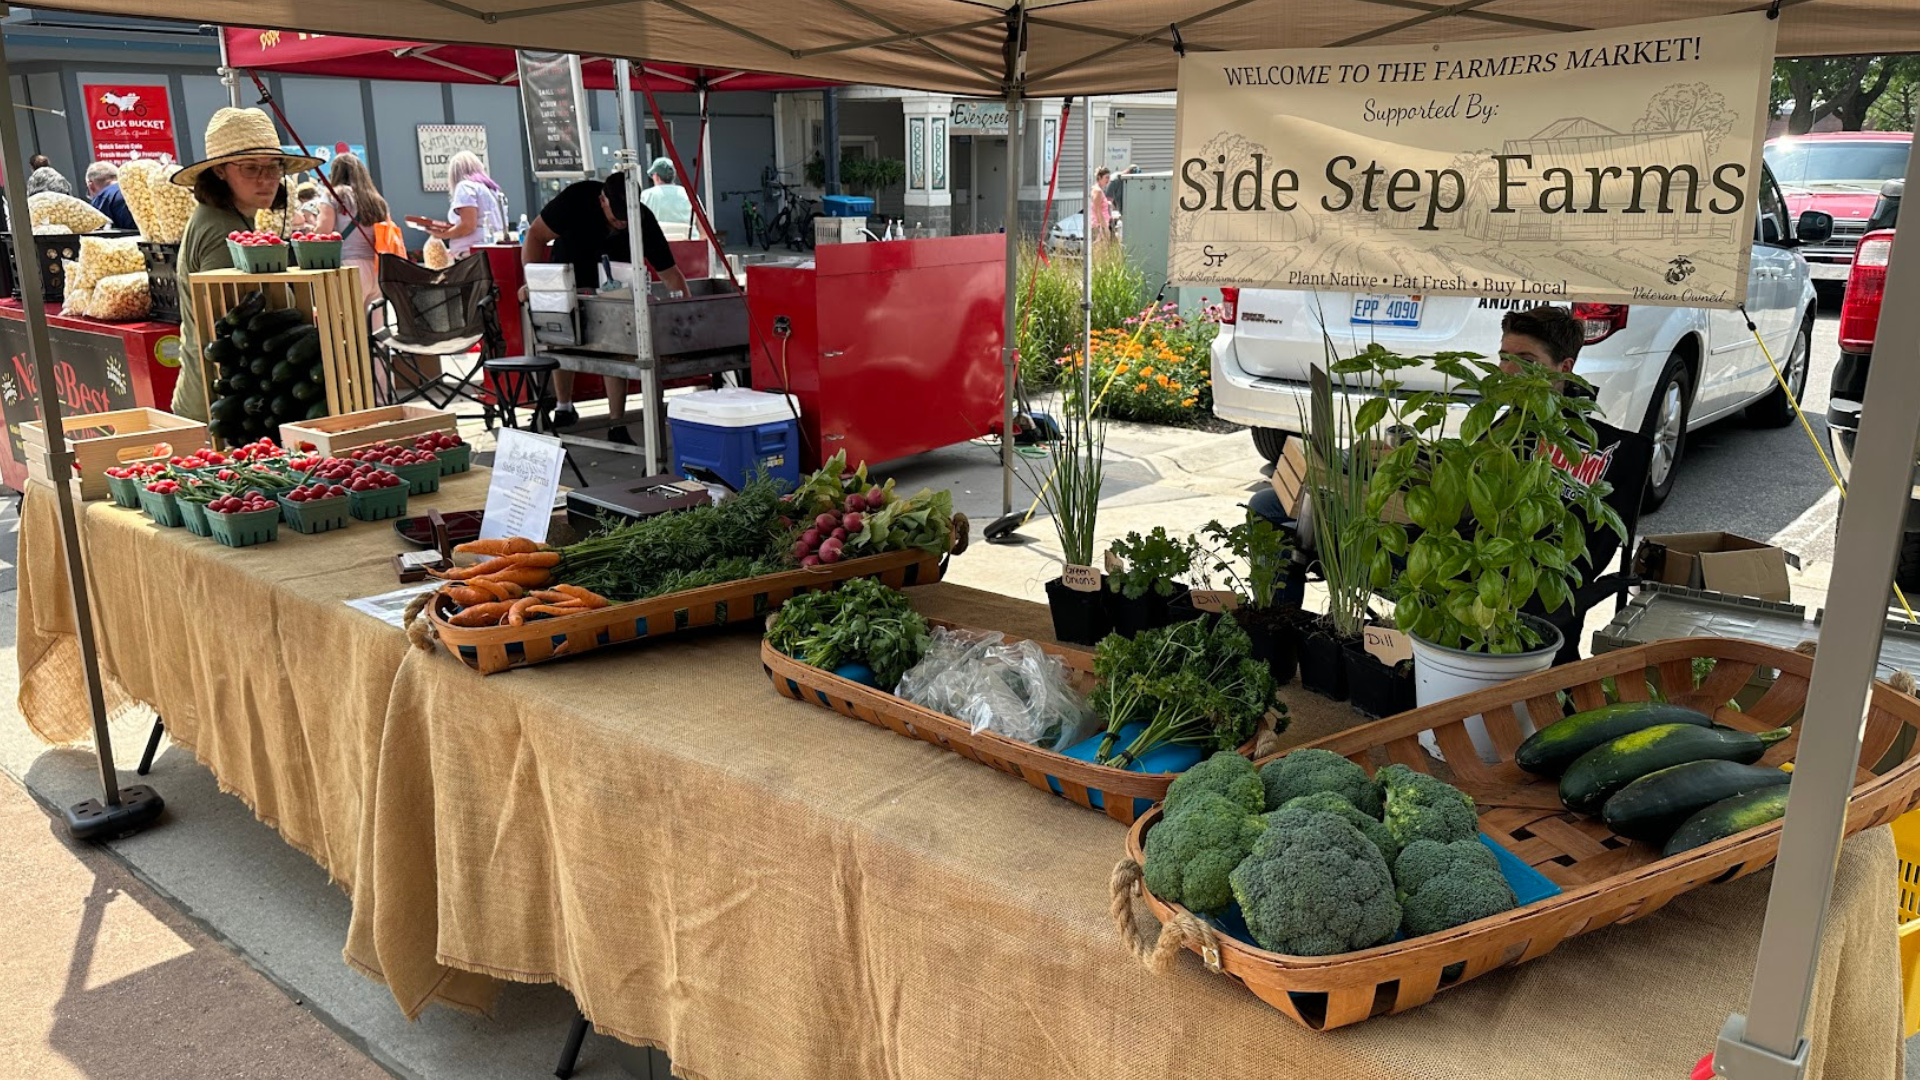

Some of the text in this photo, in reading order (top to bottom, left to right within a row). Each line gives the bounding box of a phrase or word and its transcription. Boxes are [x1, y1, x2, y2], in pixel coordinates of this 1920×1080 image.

[1223, 36, 1702, 86] WELCOME TO THE FARMERS MARKET!
[1363, 93, 1500, 127] Supported By:
[96, 120, 165, 131] CLUCK BUCKET
[913, 126, 922, 179] GROCERY
[934, 127, 943, 181] PRODUCE
[1178, 153, 1747, 231] Side Step Farms
[1288, 270, 1568, 297] Plant Native Eat Fresh Buy Local
[1632, 286, 1728, 303] Veteran Owned
[1353, 299, 1419, 320] EPP 4090
[1065, 565, 1091, 575] Green
[1065, 574, 1097, 586] Onions
[1194, 594, 1221, 606] Dill
[1364, 632, 1395, 648] Dill
